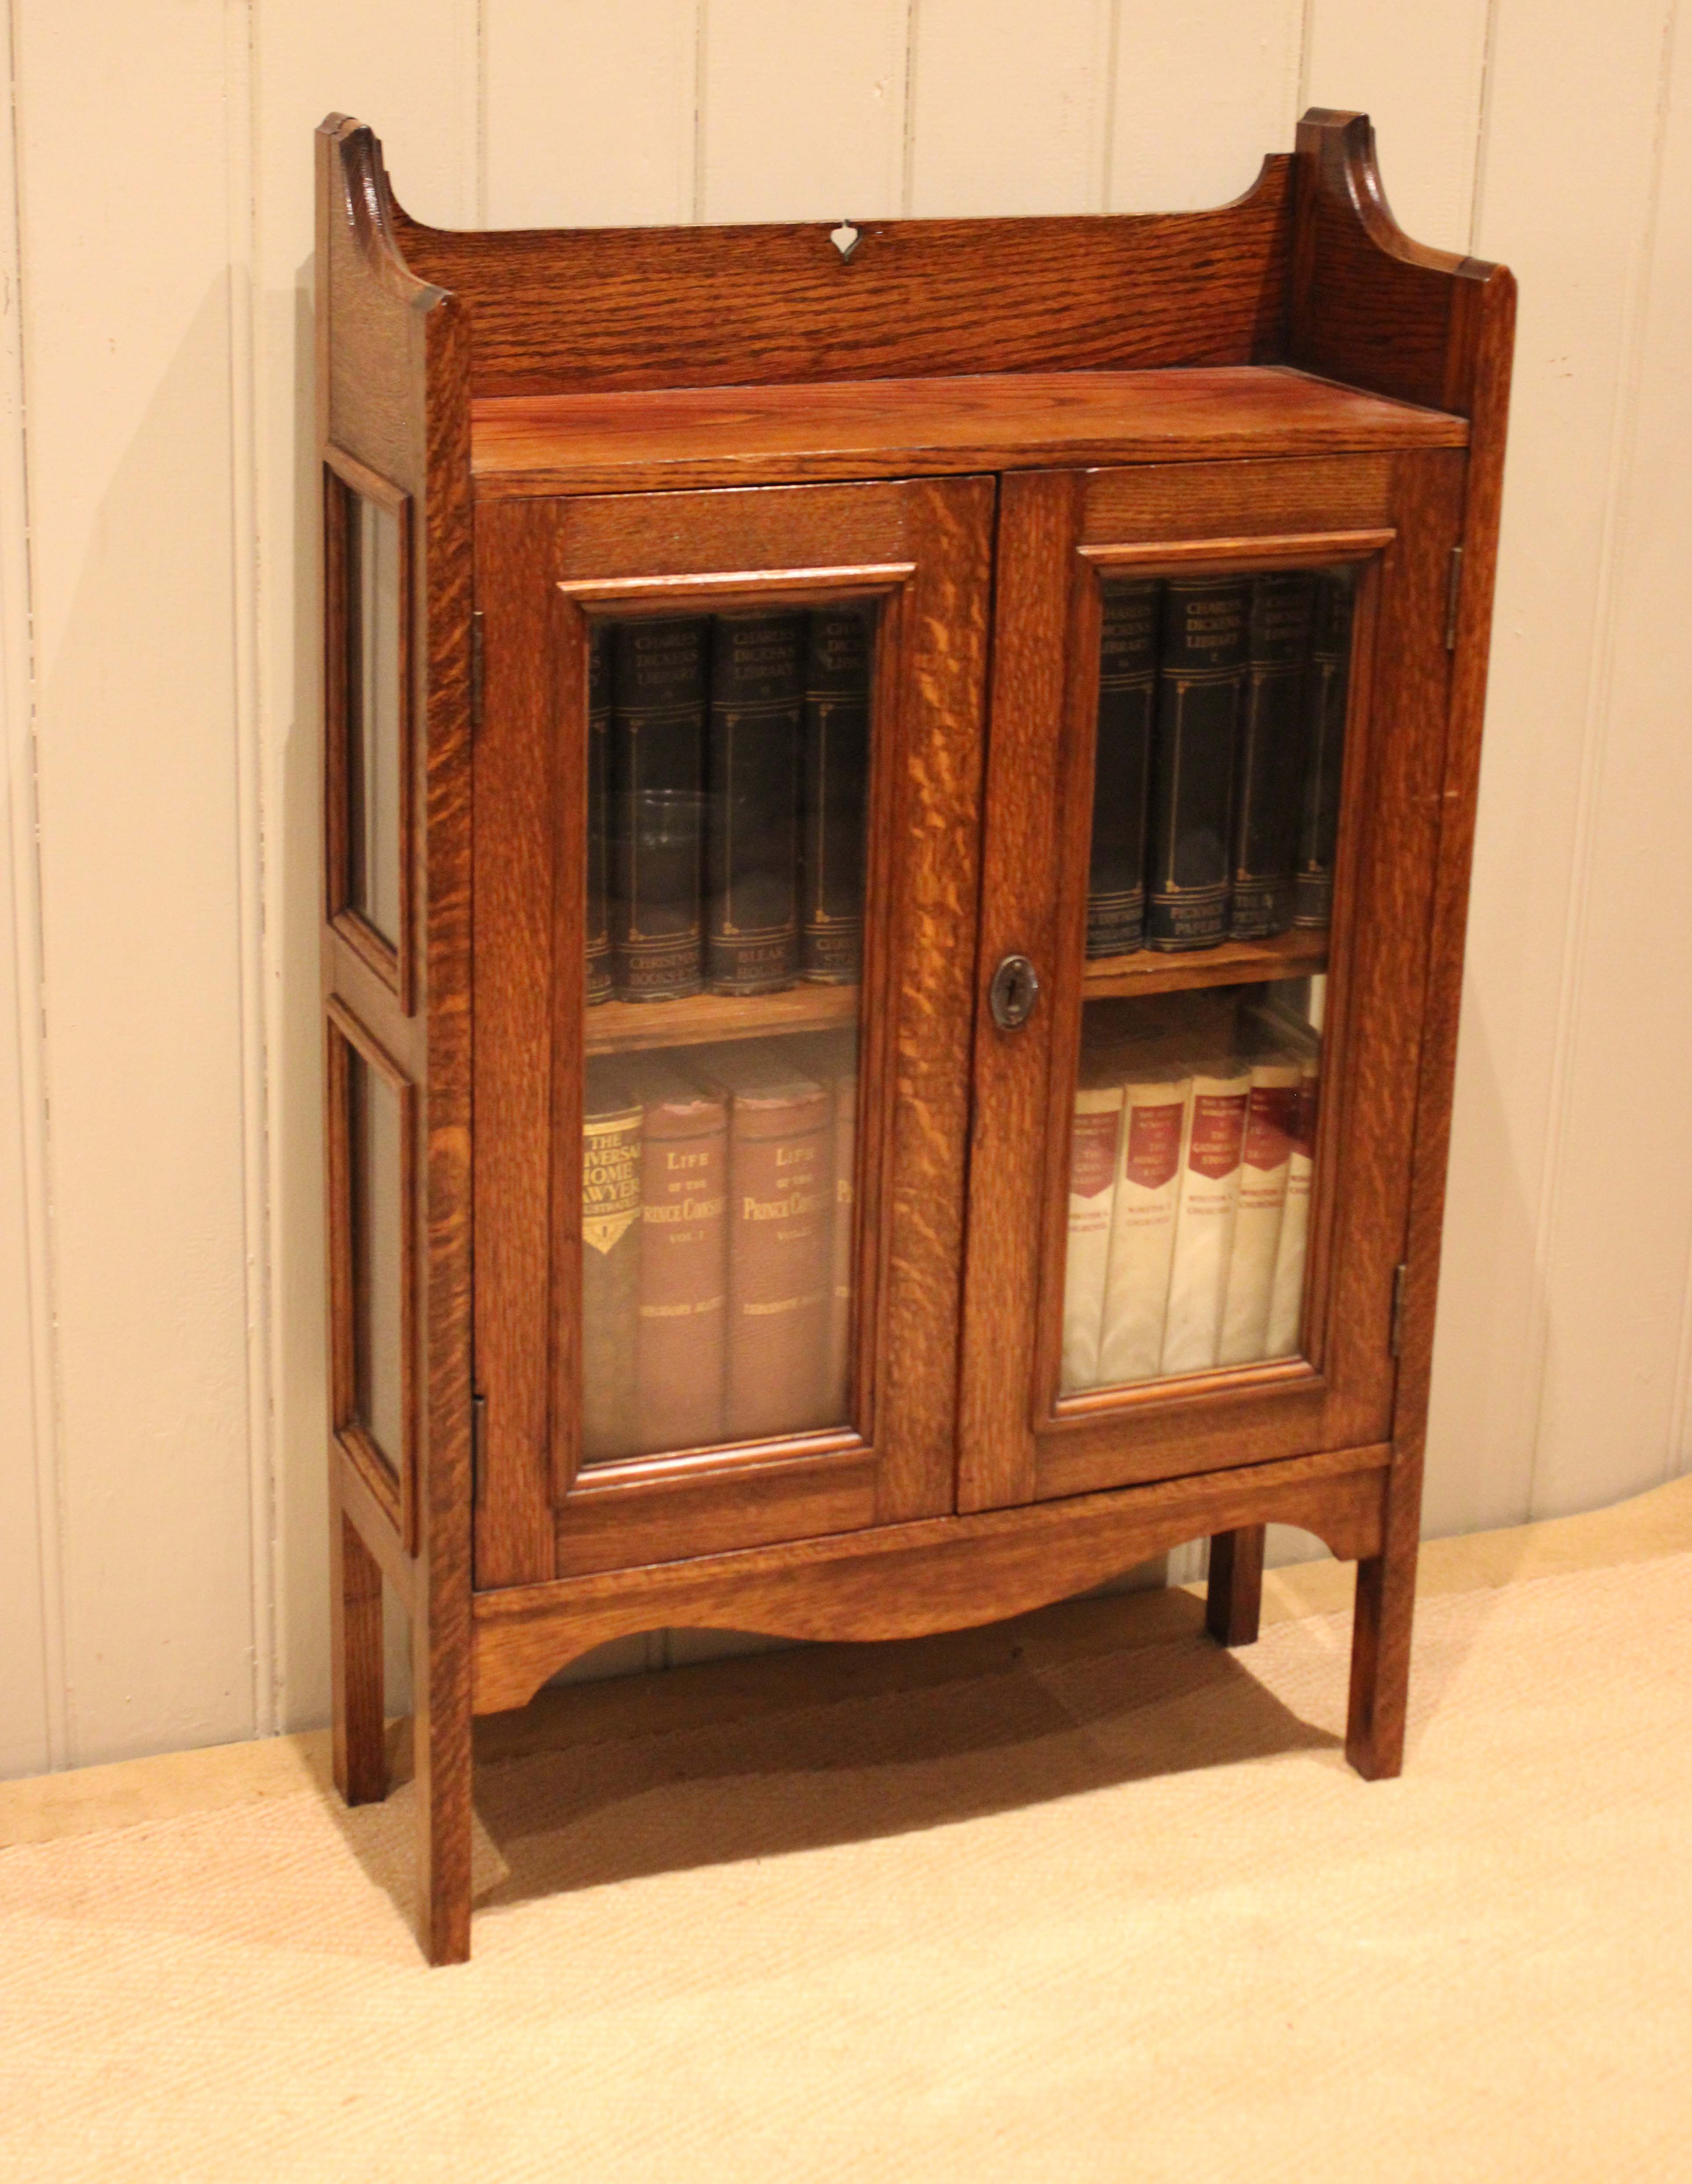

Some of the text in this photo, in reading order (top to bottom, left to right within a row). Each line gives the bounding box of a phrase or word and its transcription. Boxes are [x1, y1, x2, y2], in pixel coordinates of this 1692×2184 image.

[590, 1133, 621, 1149] THE
[667, 1152, 709, 1170] LIFE
[776, 1148, 815, 1166] LIFE
[582, 1178, 640, 1203] AWYER
[644, 1205, 681, 1223] RINCE
[742, 1197, 789, 1220] PRINCE
